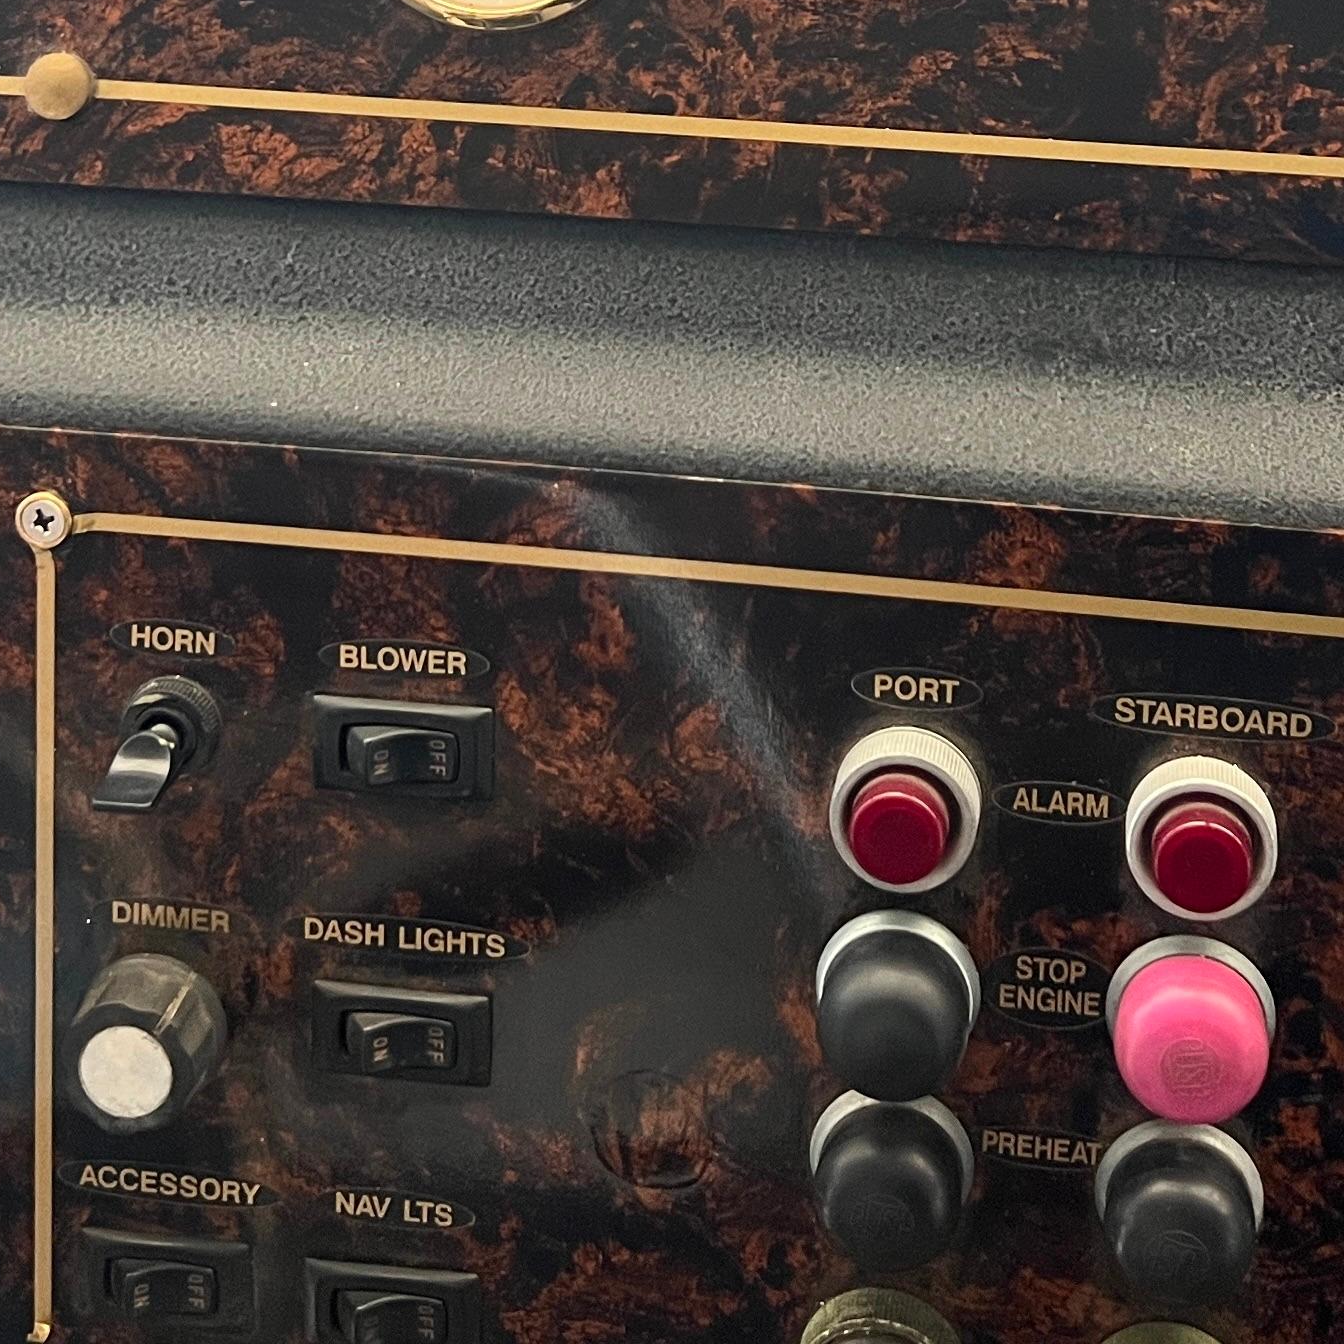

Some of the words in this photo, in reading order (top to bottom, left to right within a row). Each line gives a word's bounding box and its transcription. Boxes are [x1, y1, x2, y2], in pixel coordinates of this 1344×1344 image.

[131, 625, 216, 654] HORN
[340, 645, 467, 675] BLOWER
[874, 674, 959, 704] PORT
[1114, 697, 1312, 738] STARBOARD
[427, 738, 447, 778] OFF
[1013, 788, 1109, 819] ALARM
[112, 901, 230, 932] DIMMER
[305, 917, 385, 947] DASH
[399, 927, 506, 958] LIGHTS
[1016, 956, 1086, 984] STOP
[999, 984, 1100, 1016] ENGINE
[427, 1026, 446, 1065] OFF
[983, 1131, 1101, 1165] PREHEAT
[79, 1165, 261, 1205] ACCESSORY
[335, 1191, 393, 1218] NAV
[403, 1200, 454, 1227] LTS
[188, 1274, 206, 1311] OFF
[417, 1304, 435, 1341] OFF
